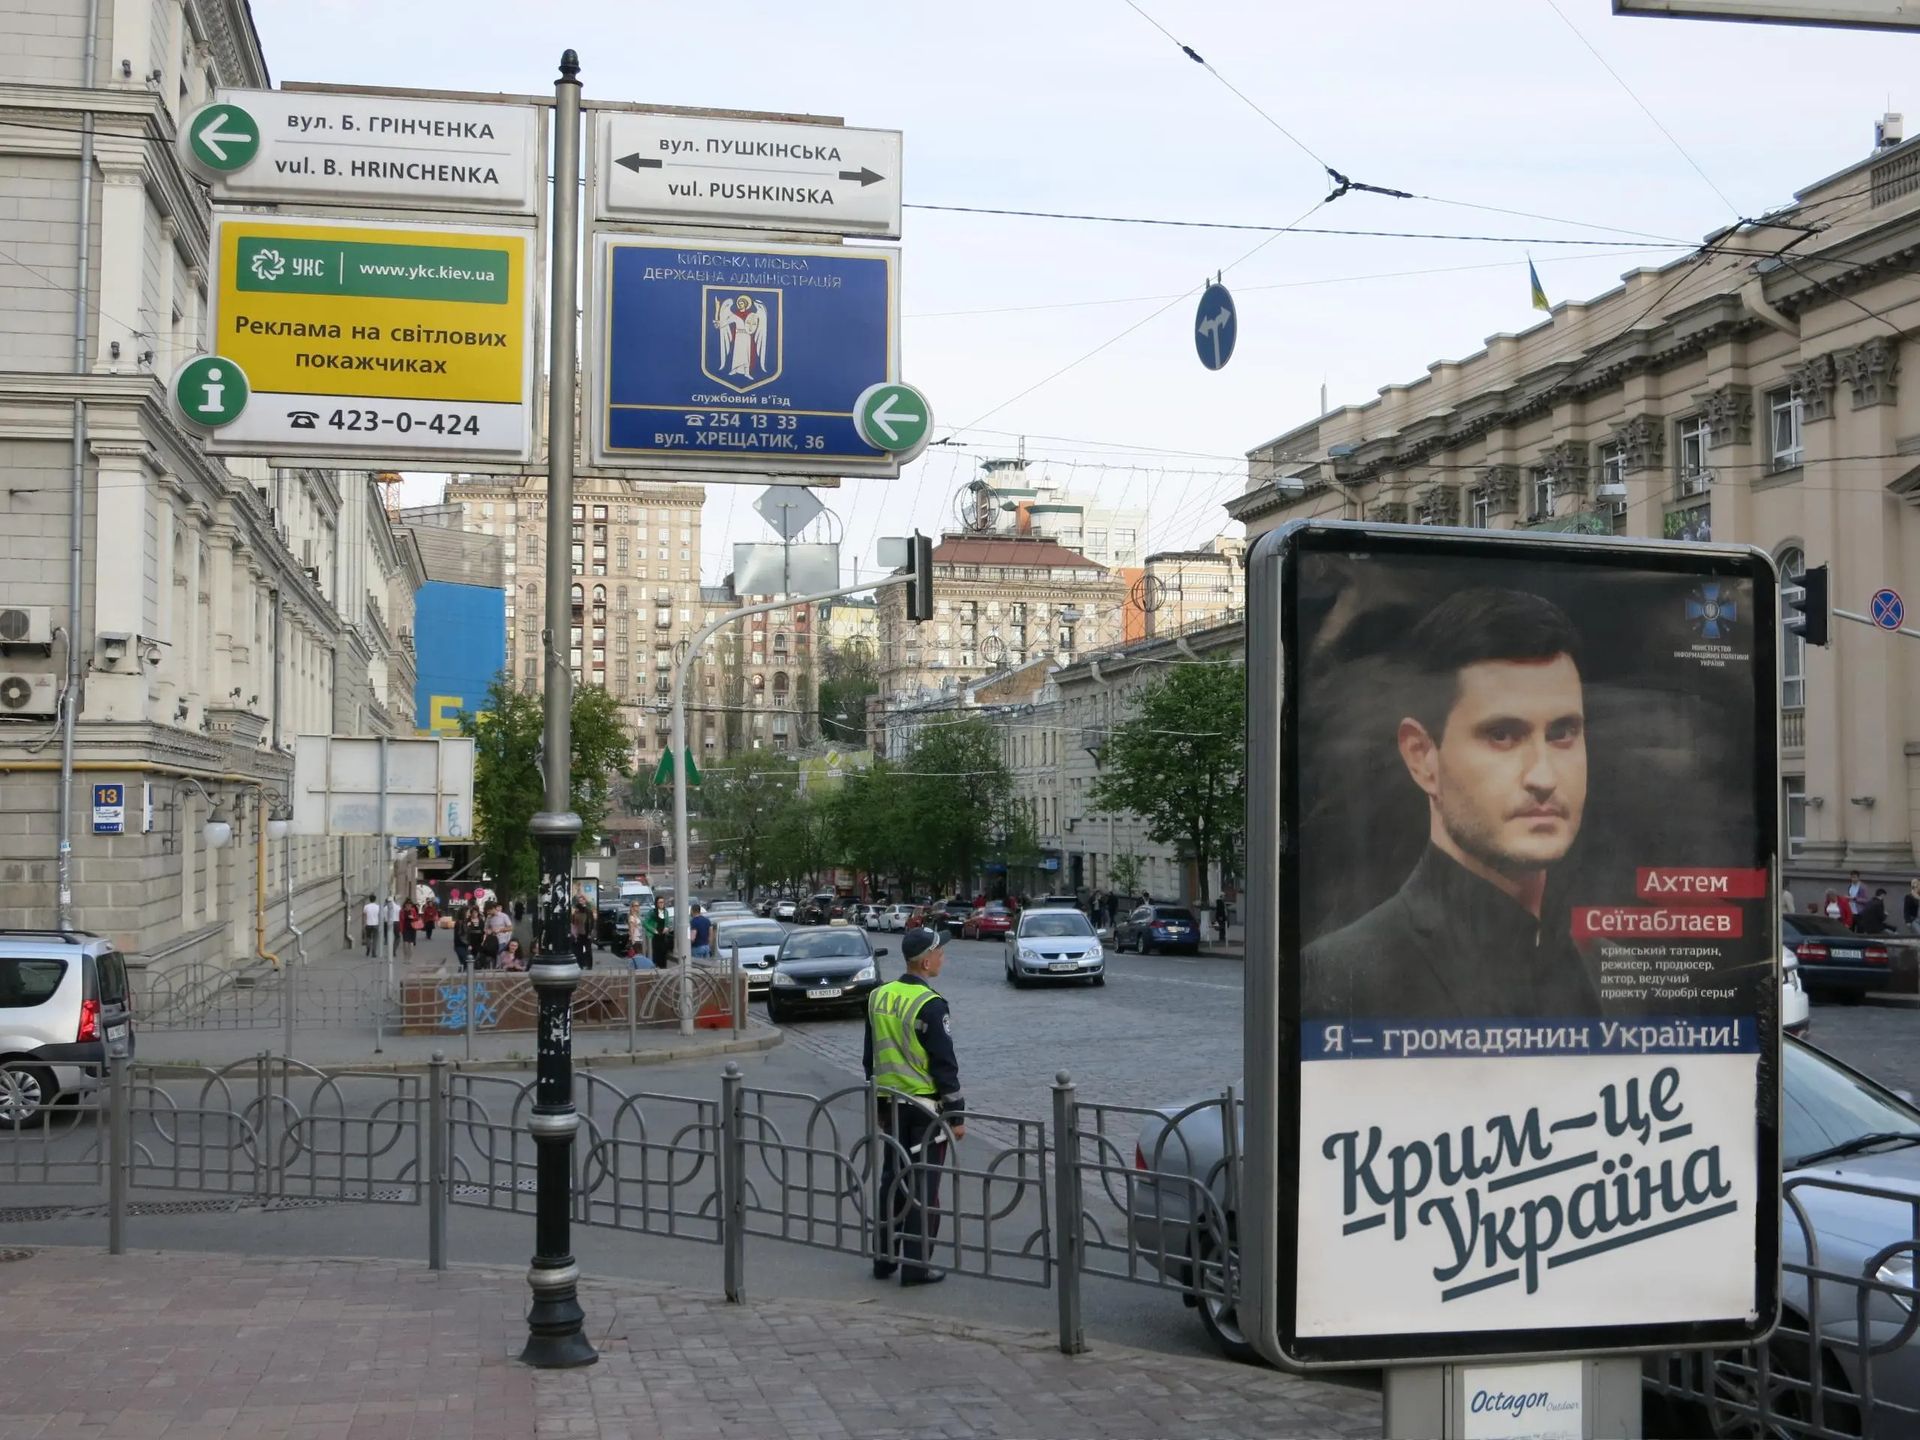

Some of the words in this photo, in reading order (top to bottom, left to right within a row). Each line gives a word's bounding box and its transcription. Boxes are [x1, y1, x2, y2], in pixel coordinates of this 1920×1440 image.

[287, 115, 333, 132] вул.
[342, 115, 360, 132] Б.
[369, 117, 495, 139] ГРІНЧЕНКА
[660, 139, 700, 155] вул.
[706, 139, 842, 161] ПУШКІНСЬКА
[275, 158, 316, 175] vul.
[324, 159, 342, 176] B.
[351, 160, 499, 184] HRINCHENKA
[668, 181, 703, 197] vul.
[710, 182, 834, 205] PUSHKINSKA
[359, 263, 496, 282] www.ykc.kiev.ua
[677, 252, 750, 268] КИЇВСЬКА
[754, 256, 809, 271] МІСЬКА
[643, 267, 725, 283] ДЕРЖАВНА
[235, 316, 341, 339] Реклама
[351, 325, 381, 341] на
[390, 324, 507, 347] світлових
[295, 352, 447, 374] покажчиках
[691, 393, 757, 406] службовий
[328, 409, 480, 436] 423-0-424
[709, 413, 741, 428] 254
[750, 415, 767, 428] 13
[777, 416, 797, 430] 33
[654, 433, 688, 446] вул.
[696, 432, 798, 450] ХРЕЩАТИК,
[805, 436, 824, 449] 36
[98, 789, 117, 803] 13
[1643, 871, 1728, 893] Ахтем
[1586, 909, 1731, 932] Сеїтаблаєв
[1601, 946, 1666, 958] кримський
[1669, 947, 1722, 958] татарин,
[1601, 961, 1652, 972] режисер,
[1655, 961, 1715, 972] продюсер,
[1601, 976, 1636, 986] актор,
[1639, 974, 1689, 986] ведучий
[1601, 989, 1647, 1000] проекту
[1323, 1025, 1343, 1052] Я
[1383, 1026, 1589, 1056] громадянин
[1600, 1020, 1741, 1053] України!
[1418, 1145, 1732, 1295] Україна
[1471, 1390, 1549, 1418] Octagon
